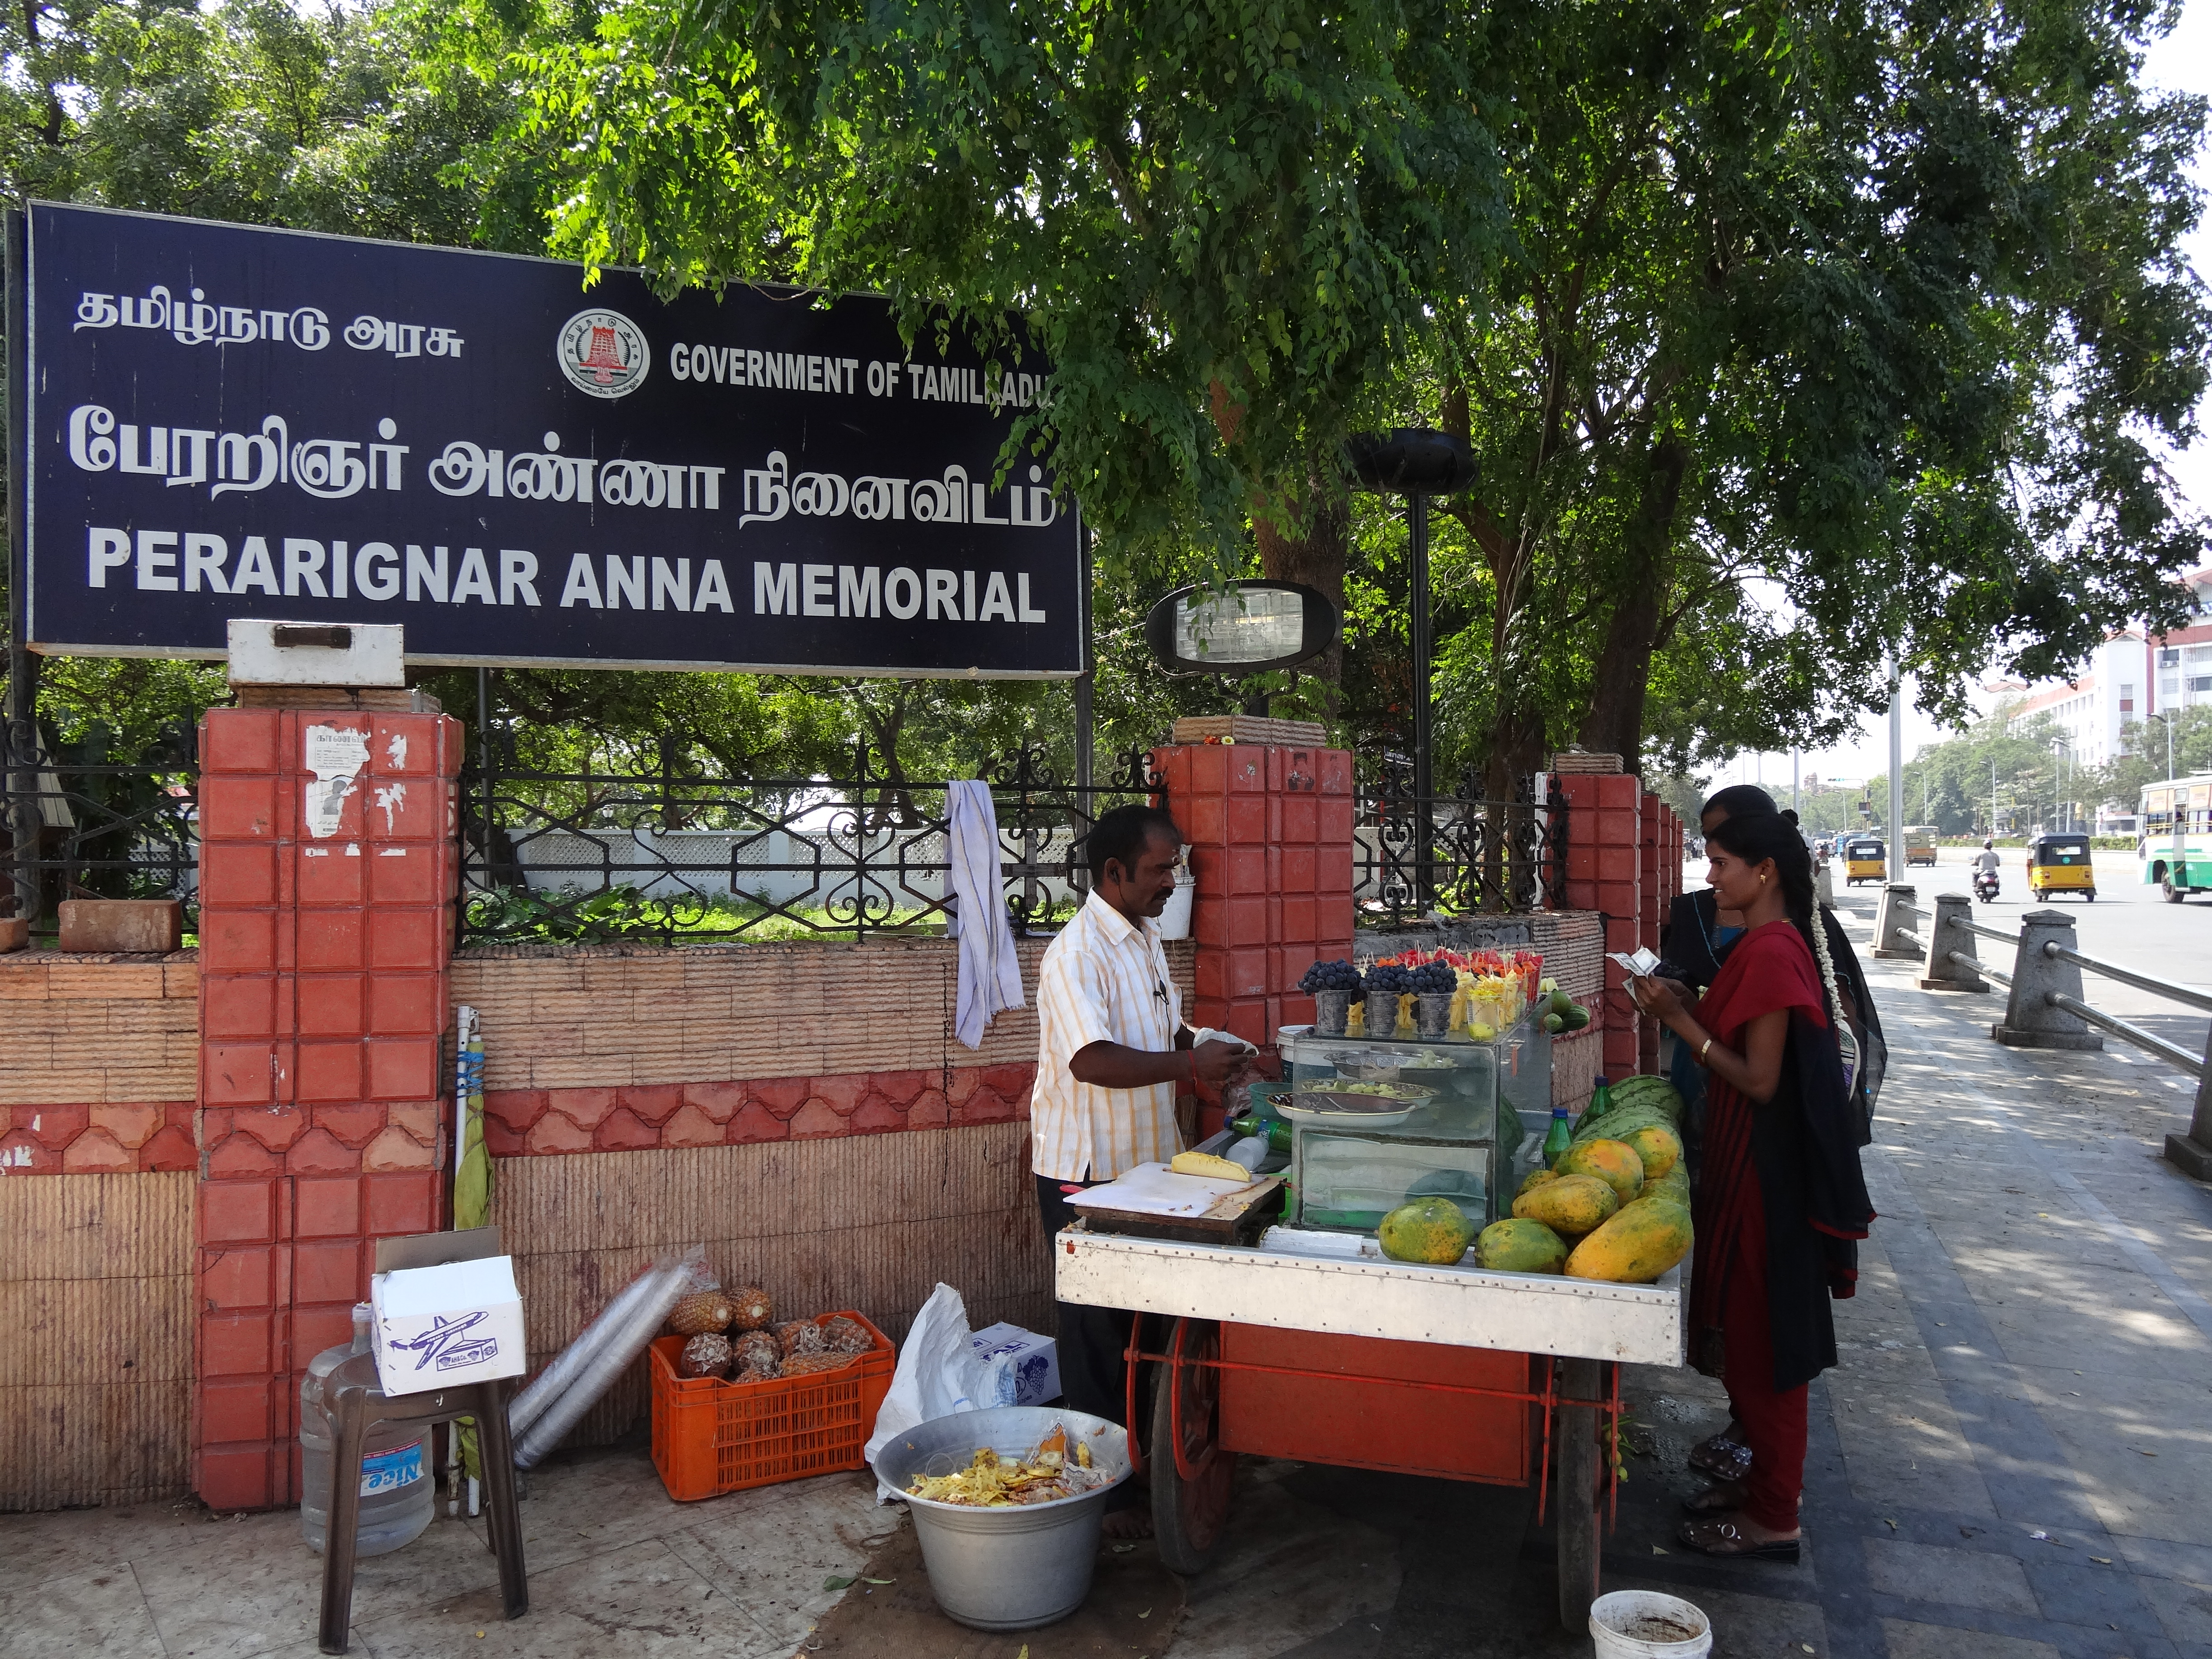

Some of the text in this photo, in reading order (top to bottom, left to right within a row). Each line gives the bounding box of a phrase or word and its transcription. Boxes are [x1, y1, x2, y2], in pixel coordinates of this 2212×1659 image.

[74, 286, 464, 359] தமிழ்நாடு அரசு
[670, 342, 858, 394] GOVERNMENT
[867, 361, 900, 397] OF
[70, 405, 1056, 530] பேரறிஞர் அண்ணா நினைவிடம்
[89, 527, 1046, 623] PERARIGNAR ANNA MEMORIAL
[368, 1463, 418, 1489] Nice
